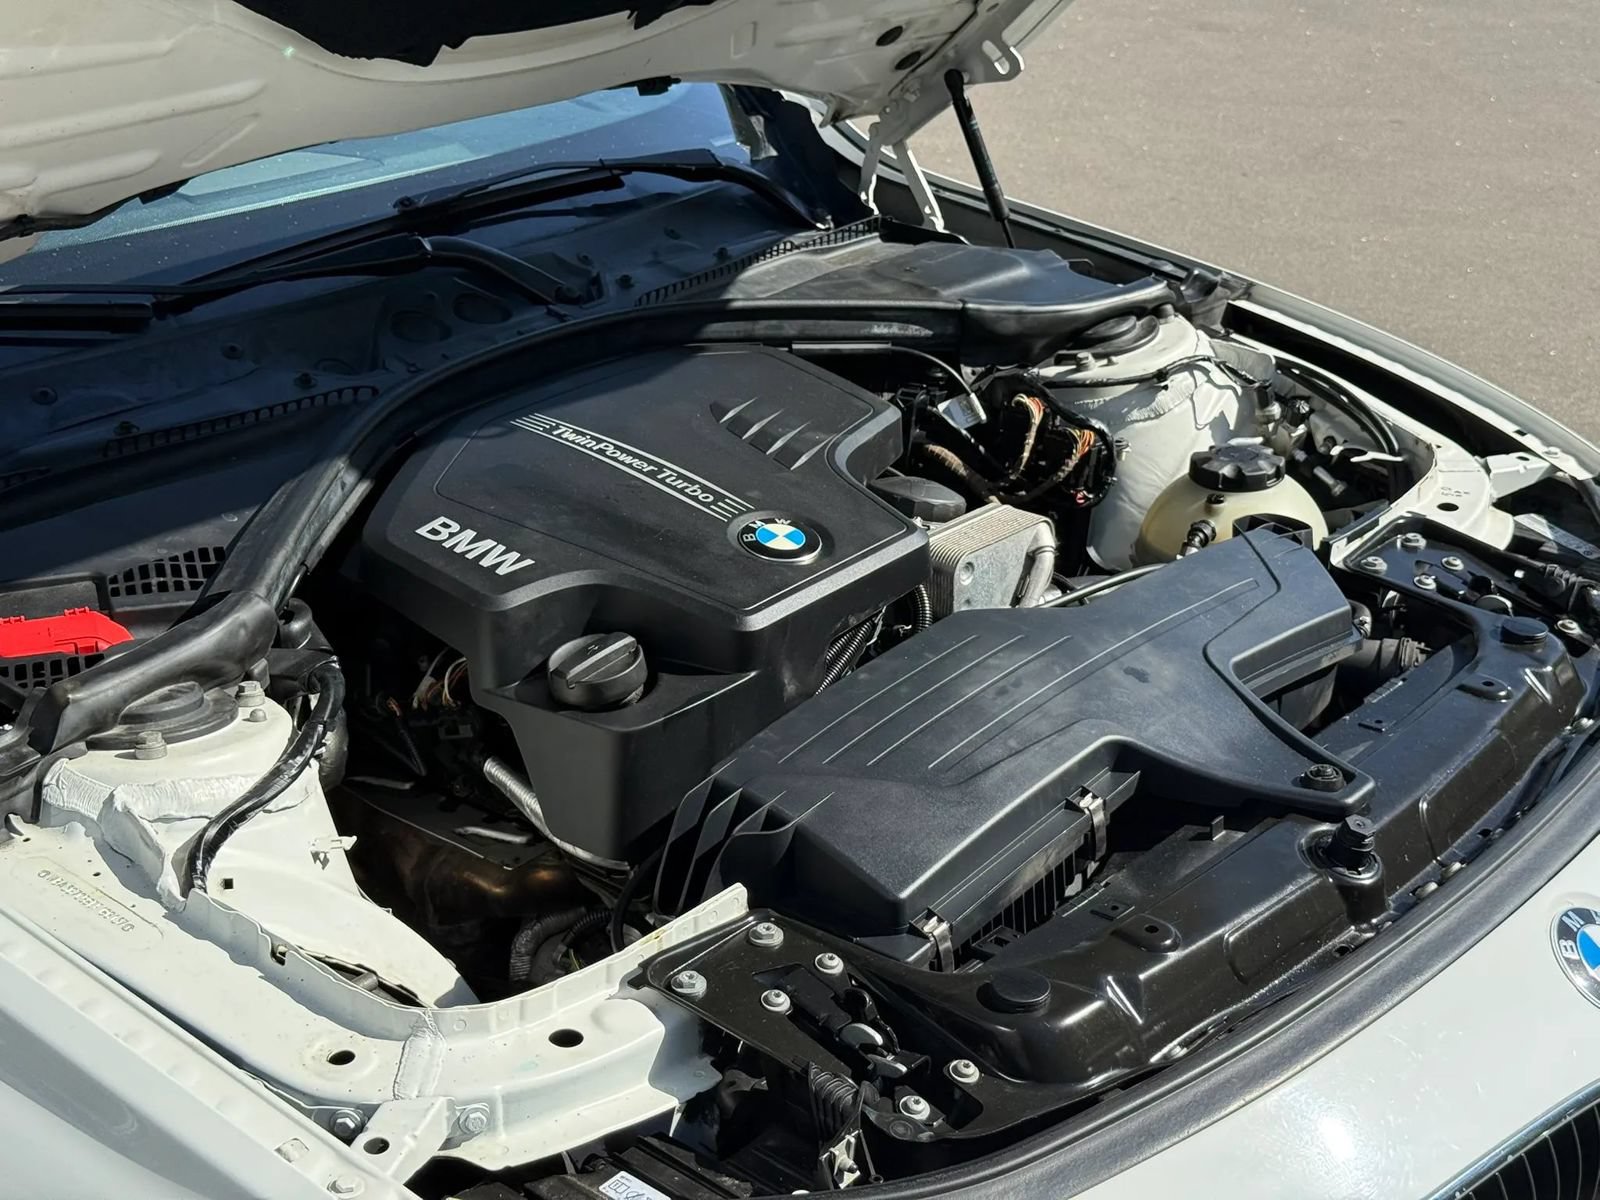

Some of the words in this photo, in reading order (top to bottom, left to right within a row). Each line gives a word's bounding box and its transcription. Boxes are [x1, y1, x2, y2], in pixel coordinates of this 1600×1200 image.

[552, 425, 658, 473] TwinPower
[656, 468, 714, 502] Turbo
[415, 515, 535, 576] BMW
[742, 518, 792, 542] BMW
